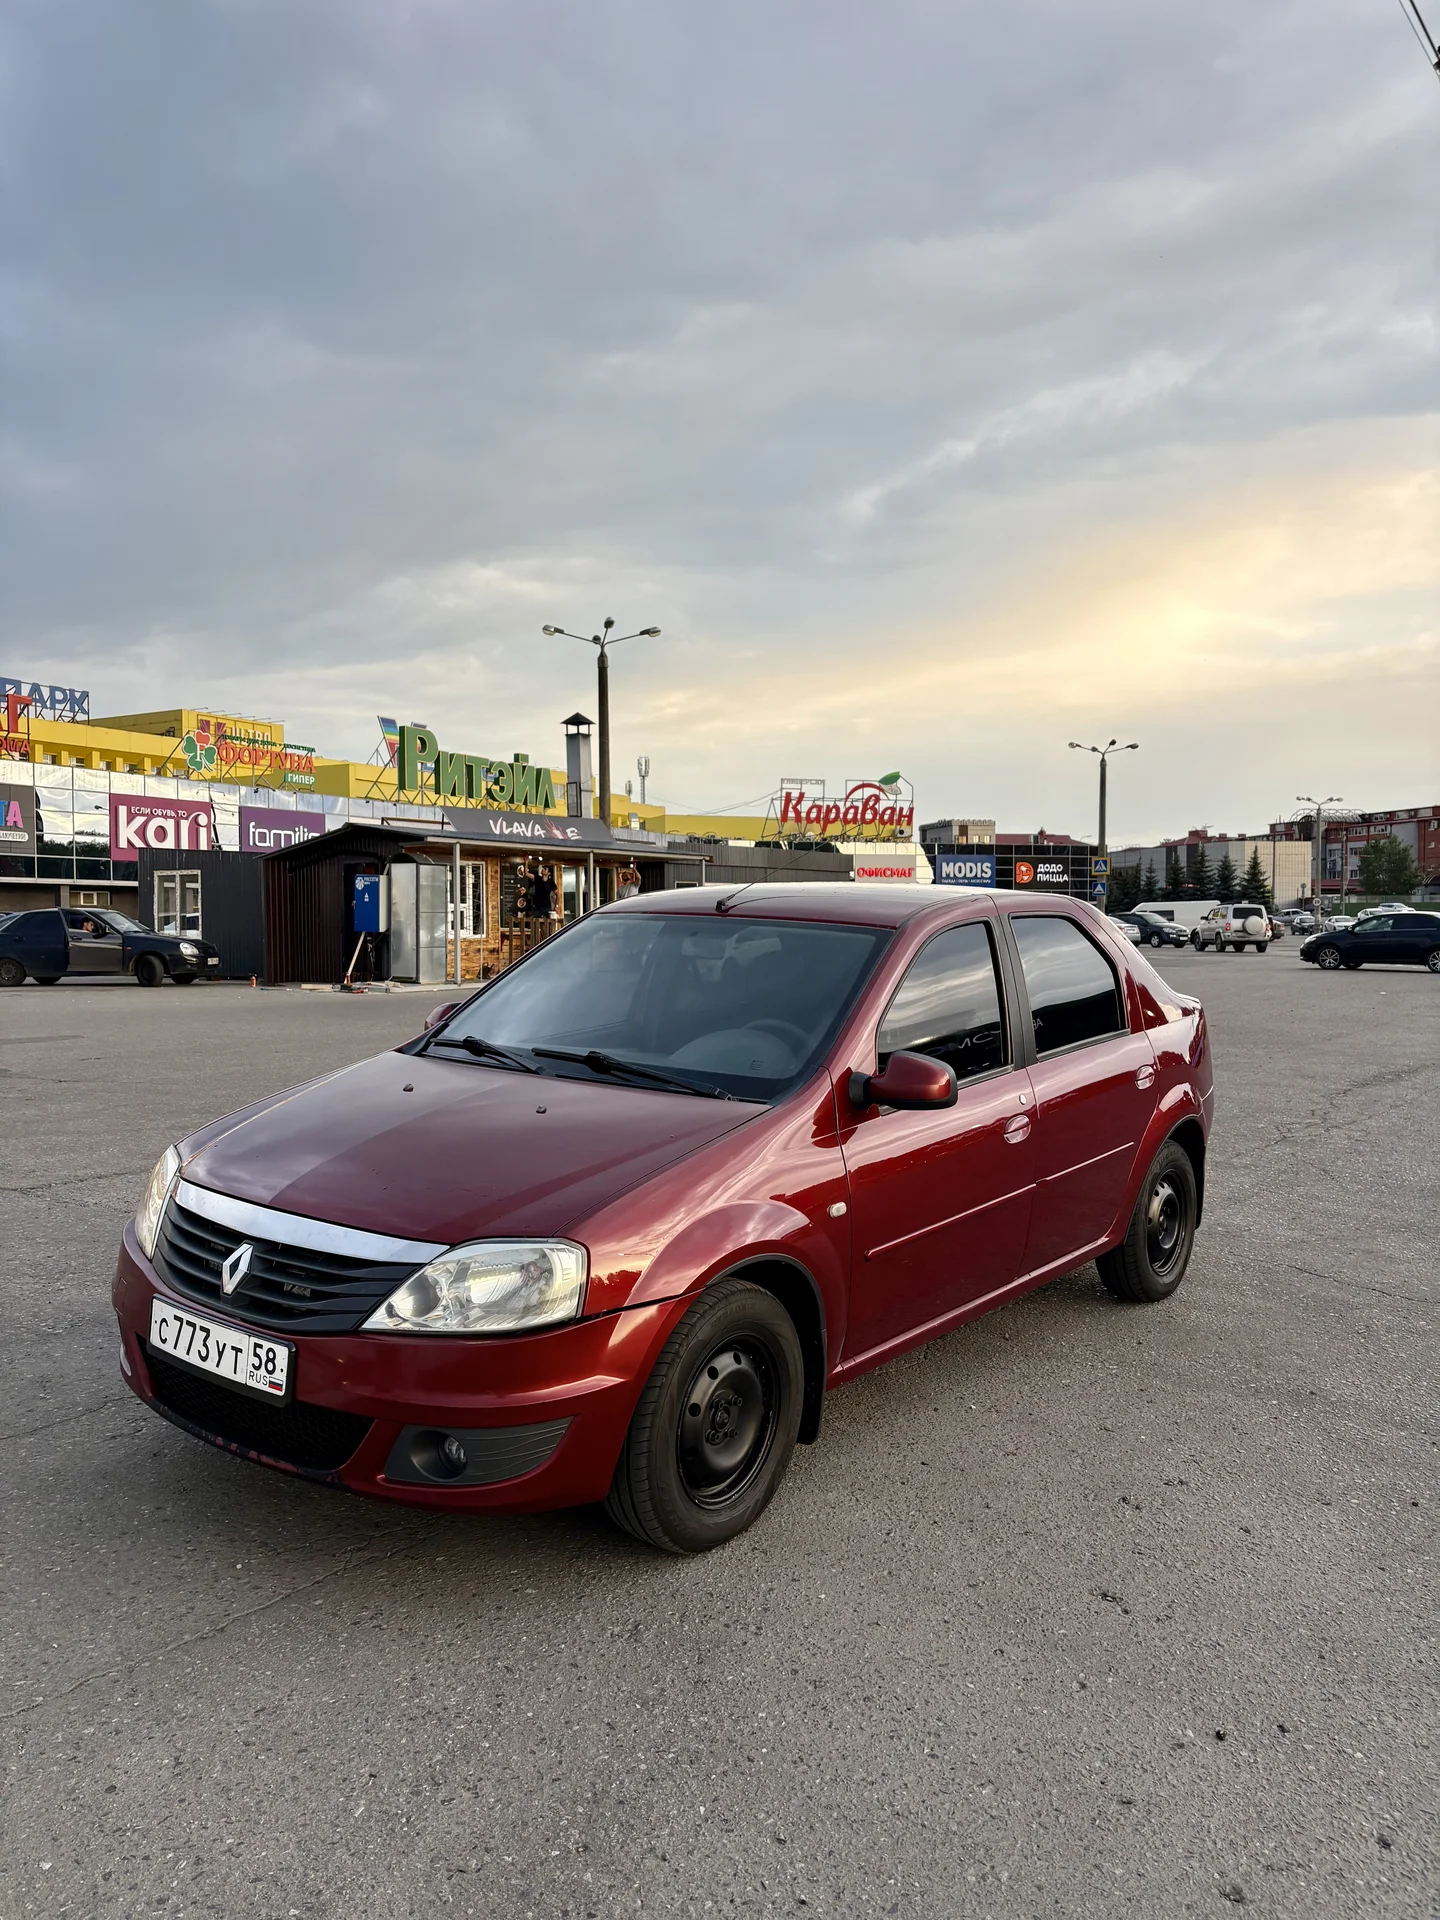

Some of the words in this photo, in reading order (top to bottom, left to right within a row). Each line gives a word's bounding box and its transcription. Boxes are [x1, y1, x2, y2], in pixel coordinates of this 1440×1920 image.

[217, 741, 316, 773] ФОРТУНА
[287, 773, 315, 785] ГИПЕР
[131, 806, 151, 814] ЕСЛИ
[152, 808, 177, 818] ОБУВЬ,
[780, 791, 914, 834] Караван
[117, 805, 208, 850] kari
[857, 867, 915, 878] ОФИСМАГ
[941, 862, 992, 878] MODIS
[1037, 864, 1063, 873] ДОДО
[1037, 874, 1069, 883] ПИЦЦА
[251, 1342, 277, 1375] 58
[248, 1370, 268, 1386] RUS
